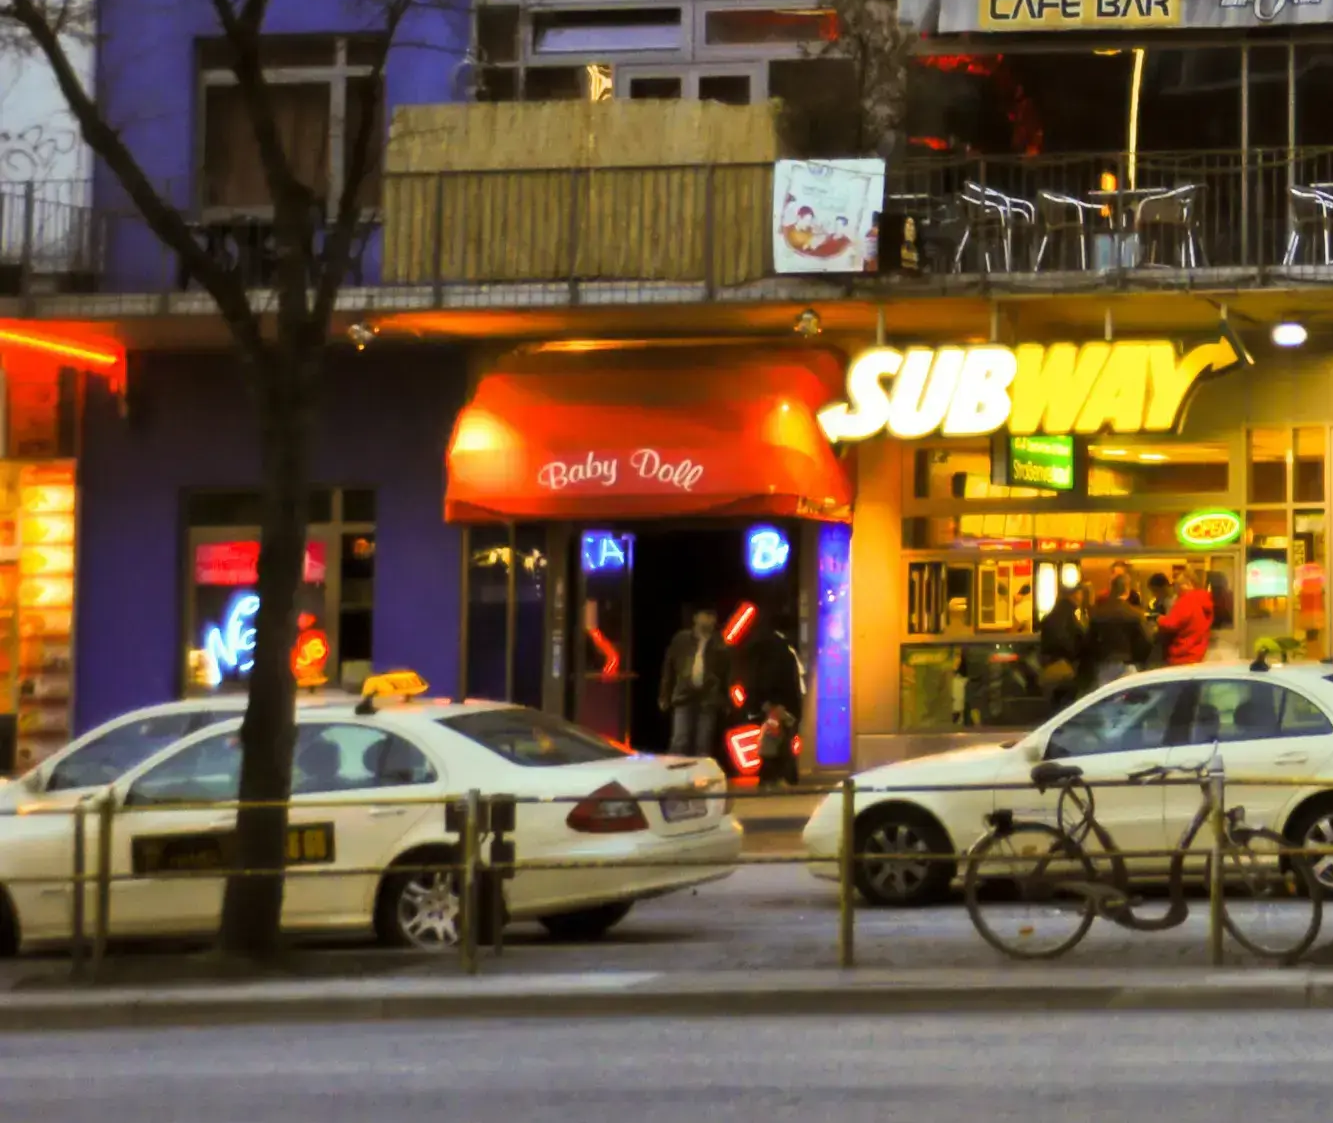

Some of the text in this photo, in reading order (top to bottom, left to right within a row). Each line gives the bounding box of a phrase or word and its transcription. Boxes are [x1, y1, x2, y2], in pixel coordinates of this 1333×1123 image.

[817, 336, 1238, 445] SUBWAY
[537, 448, 704, 492] Baby Doll
[1187, 519, 1234, 539] OPEN
